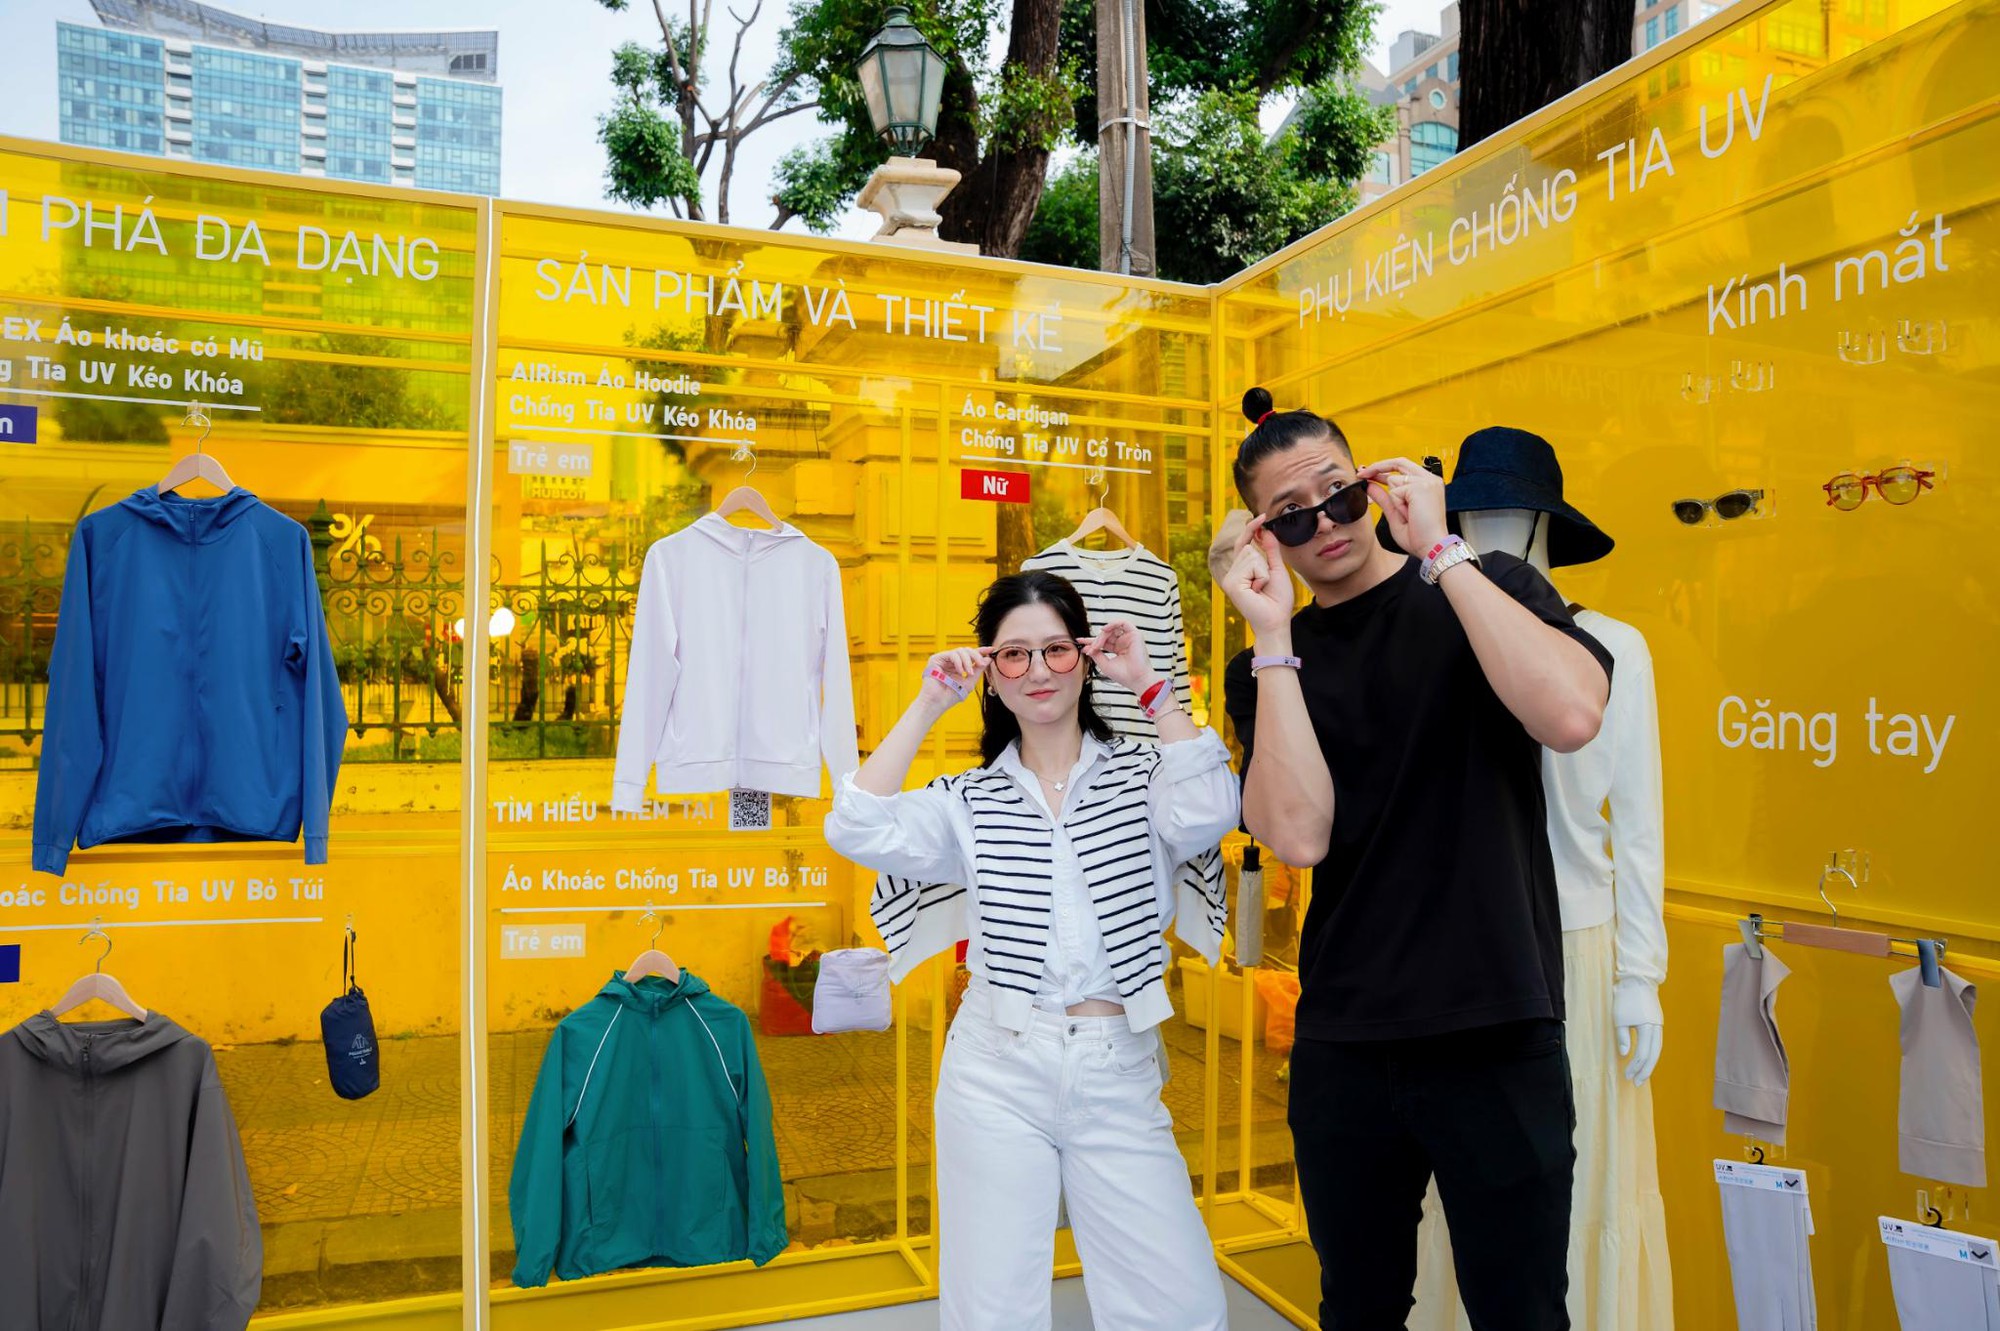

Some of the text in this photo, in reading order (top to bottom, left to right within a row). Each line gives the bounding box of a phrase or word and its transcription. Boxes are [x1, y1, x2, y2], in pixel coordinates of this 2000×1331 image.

[1299, 73, 1774, 329] PHỤ KIỆN CHỐNG TIA UV
[41, 195, 169, 256] PHÁ
[195, 214, 271, 266] ĐA
[297, 225, 440, 284] DẠNG
[1707, 210, 1952, 336] Kính mắt
[535, 249, 1064, 352] SẢN PHẨM VÀ THIẾT KẾ
[54, 316, 93, 347] Áo
[104, 326, 180, 354] khoác
[190, 336, 218, 358] có
[229, 337, 264, 361] Mũ
[25, 355, 67, 382] Tia
[80, 360, 117, 385] UV
[128, 364, 173, 390] Kéo
[184, 368, 244, 395] Khóa
[511, 362, 702, 396] AIRism Áo Hoodie
[509, 395, 757, 432] Chống Tia UV Kéo Khóa
[961, 393, 1069, 429] Áo Cardigan
[512, 443, 591, 470] Trẻ em
[960, 428, 1152, 462] Chống Tia UV Cổ Tròn
[982, 475, 1010, 496] Nữ
[1717, 695, 1956, 774] Găng tay
[493, 797, 533, 823] TÌM
[542, 791, 598, 822] HIỂU
[680, 799, 714, 826] TẠI
[60, 880, 140, 909] Chống
[152, 880, 190, 903] Tia
[201, 879, 236, 902] UV
[247, 878, 278, 901] Bỏ
[288, 878, 324, 900] Túi
[502, 864, 828, 895] Áo Khoác Chống Tia UV Bỏ Túi
[504, 928, 582, 951] Trẻ em
[1959, 1249, 1969, 1260] M
